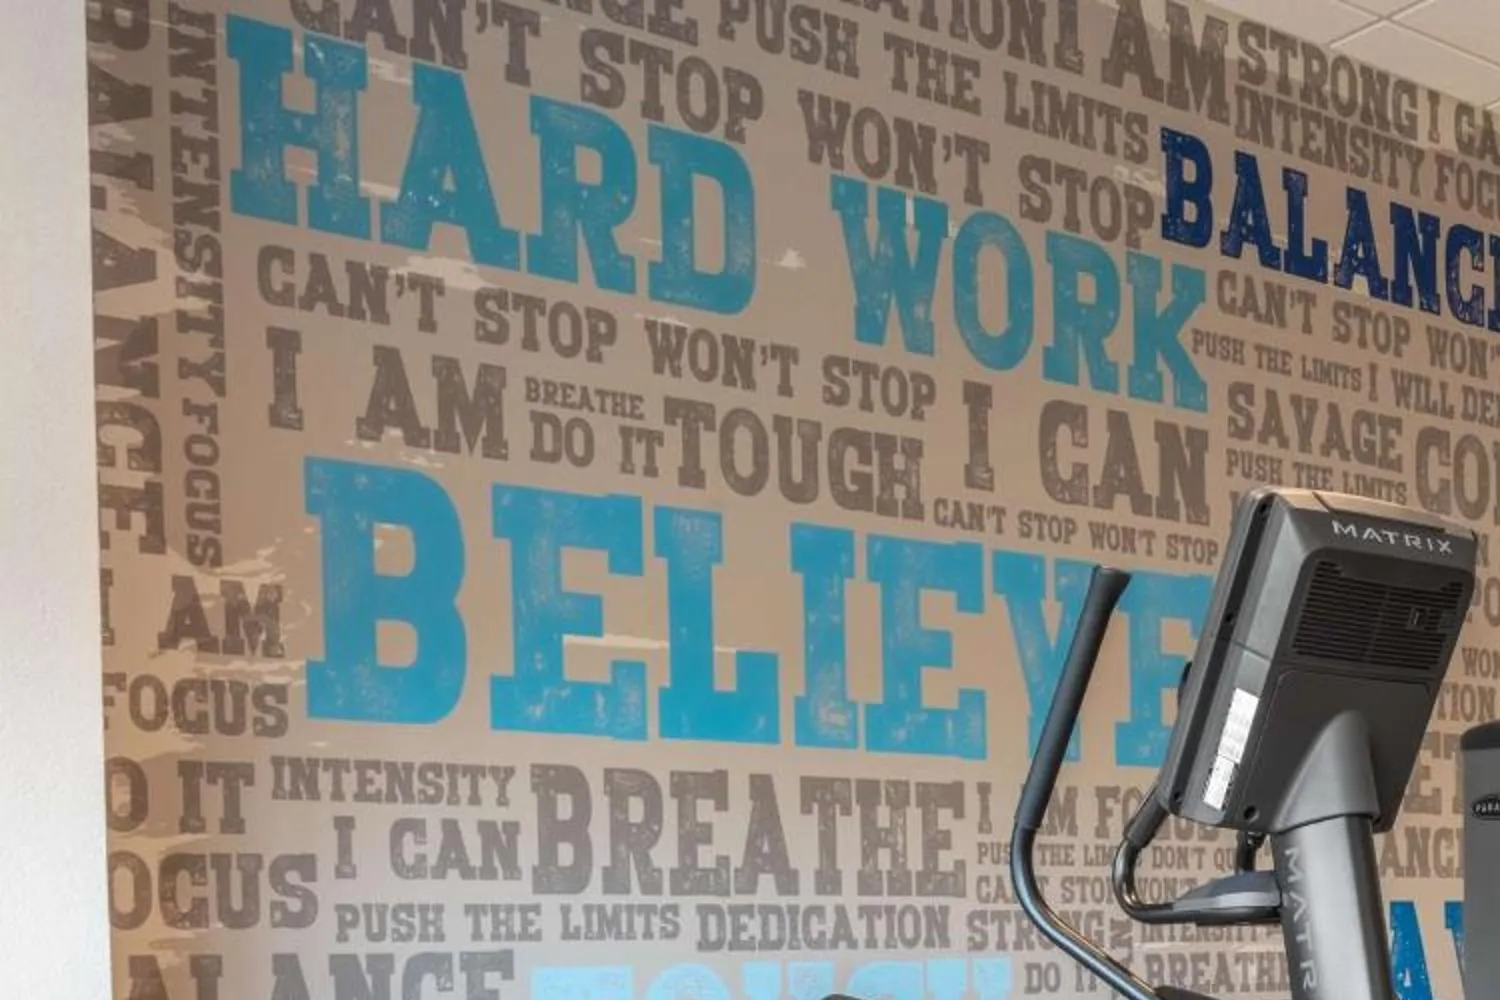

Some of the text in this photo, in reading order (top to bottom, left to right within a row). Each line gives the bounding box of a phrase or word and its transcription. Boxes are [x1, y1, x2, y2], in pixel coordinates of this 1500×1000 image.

[718, 0, 860, 79] PUSH
[884, 31, 981, 117] THE
[1003, 70, 1149, 164] LIMITS
[1054, 0, 1084, 76] I
[1101, 0, 1230, 126] AM
[1236, 20, 1418, 142] STRONG
[1426, 88, 1442, 145] I
[579, 27, 763, 144] STOP
[797, 88, 990, 207] WON'T
[1018, 154, 1155, 250] STOP
[1234, 85, 1424, 196] INTENSITY
[225, 13, 1208, 413] HARD WORK
[168, 2, 225, 568] INTENSITY FOCUS
[1216, 268, 1317, 336] CAN'T
[1331, 300, 1411, 358] STOP
[257, 244, 936, 421] CAN'T STOP WON'T STOP
[1191, 328, 1246, 366] PUSH
[1254, 343, 1294, 377] THE
[1301, 354, 1363, 393] LIMITS
[1368, 361, 1379, 402] I
[1391, 366, 1455, 420] WILL
[265, 326, 508, 461] I AM
[525, 377, 645, 420] BREATHE
[1226, 380, 1403, 474] SAVAGE
[529, 411, 664, 477] DO IT
[663, 380, 1210, 526] TOUGH I CAN
[1225, 447, 1408, 506] PUSH THE LIMITS
[933, 497, 1219, 566] CAN'T STOP WON'T STOP
[1331, 519, 1454, 554] MATRIX
[158, 574, 286, 658] AM
[303, 456, 1214, 769] BELIEVE
[177, 760, 255, 834] IT
[270, 755, 516, 807] INTENSITY
[333, 815, 523, 881] I CAN
[530, 762, 967, 898] BREATHE
[1038, 843, 1075, 867] THE
[1152, 846, 1206, 870] DON'T
[108, 850, 319, 930] OCUS
[333, 902, 682, 943] PUSH THE LIMITS
[695, 903, 1105, 952] DEDICATION STRG
[1024, 962, 1061, 995] DO
